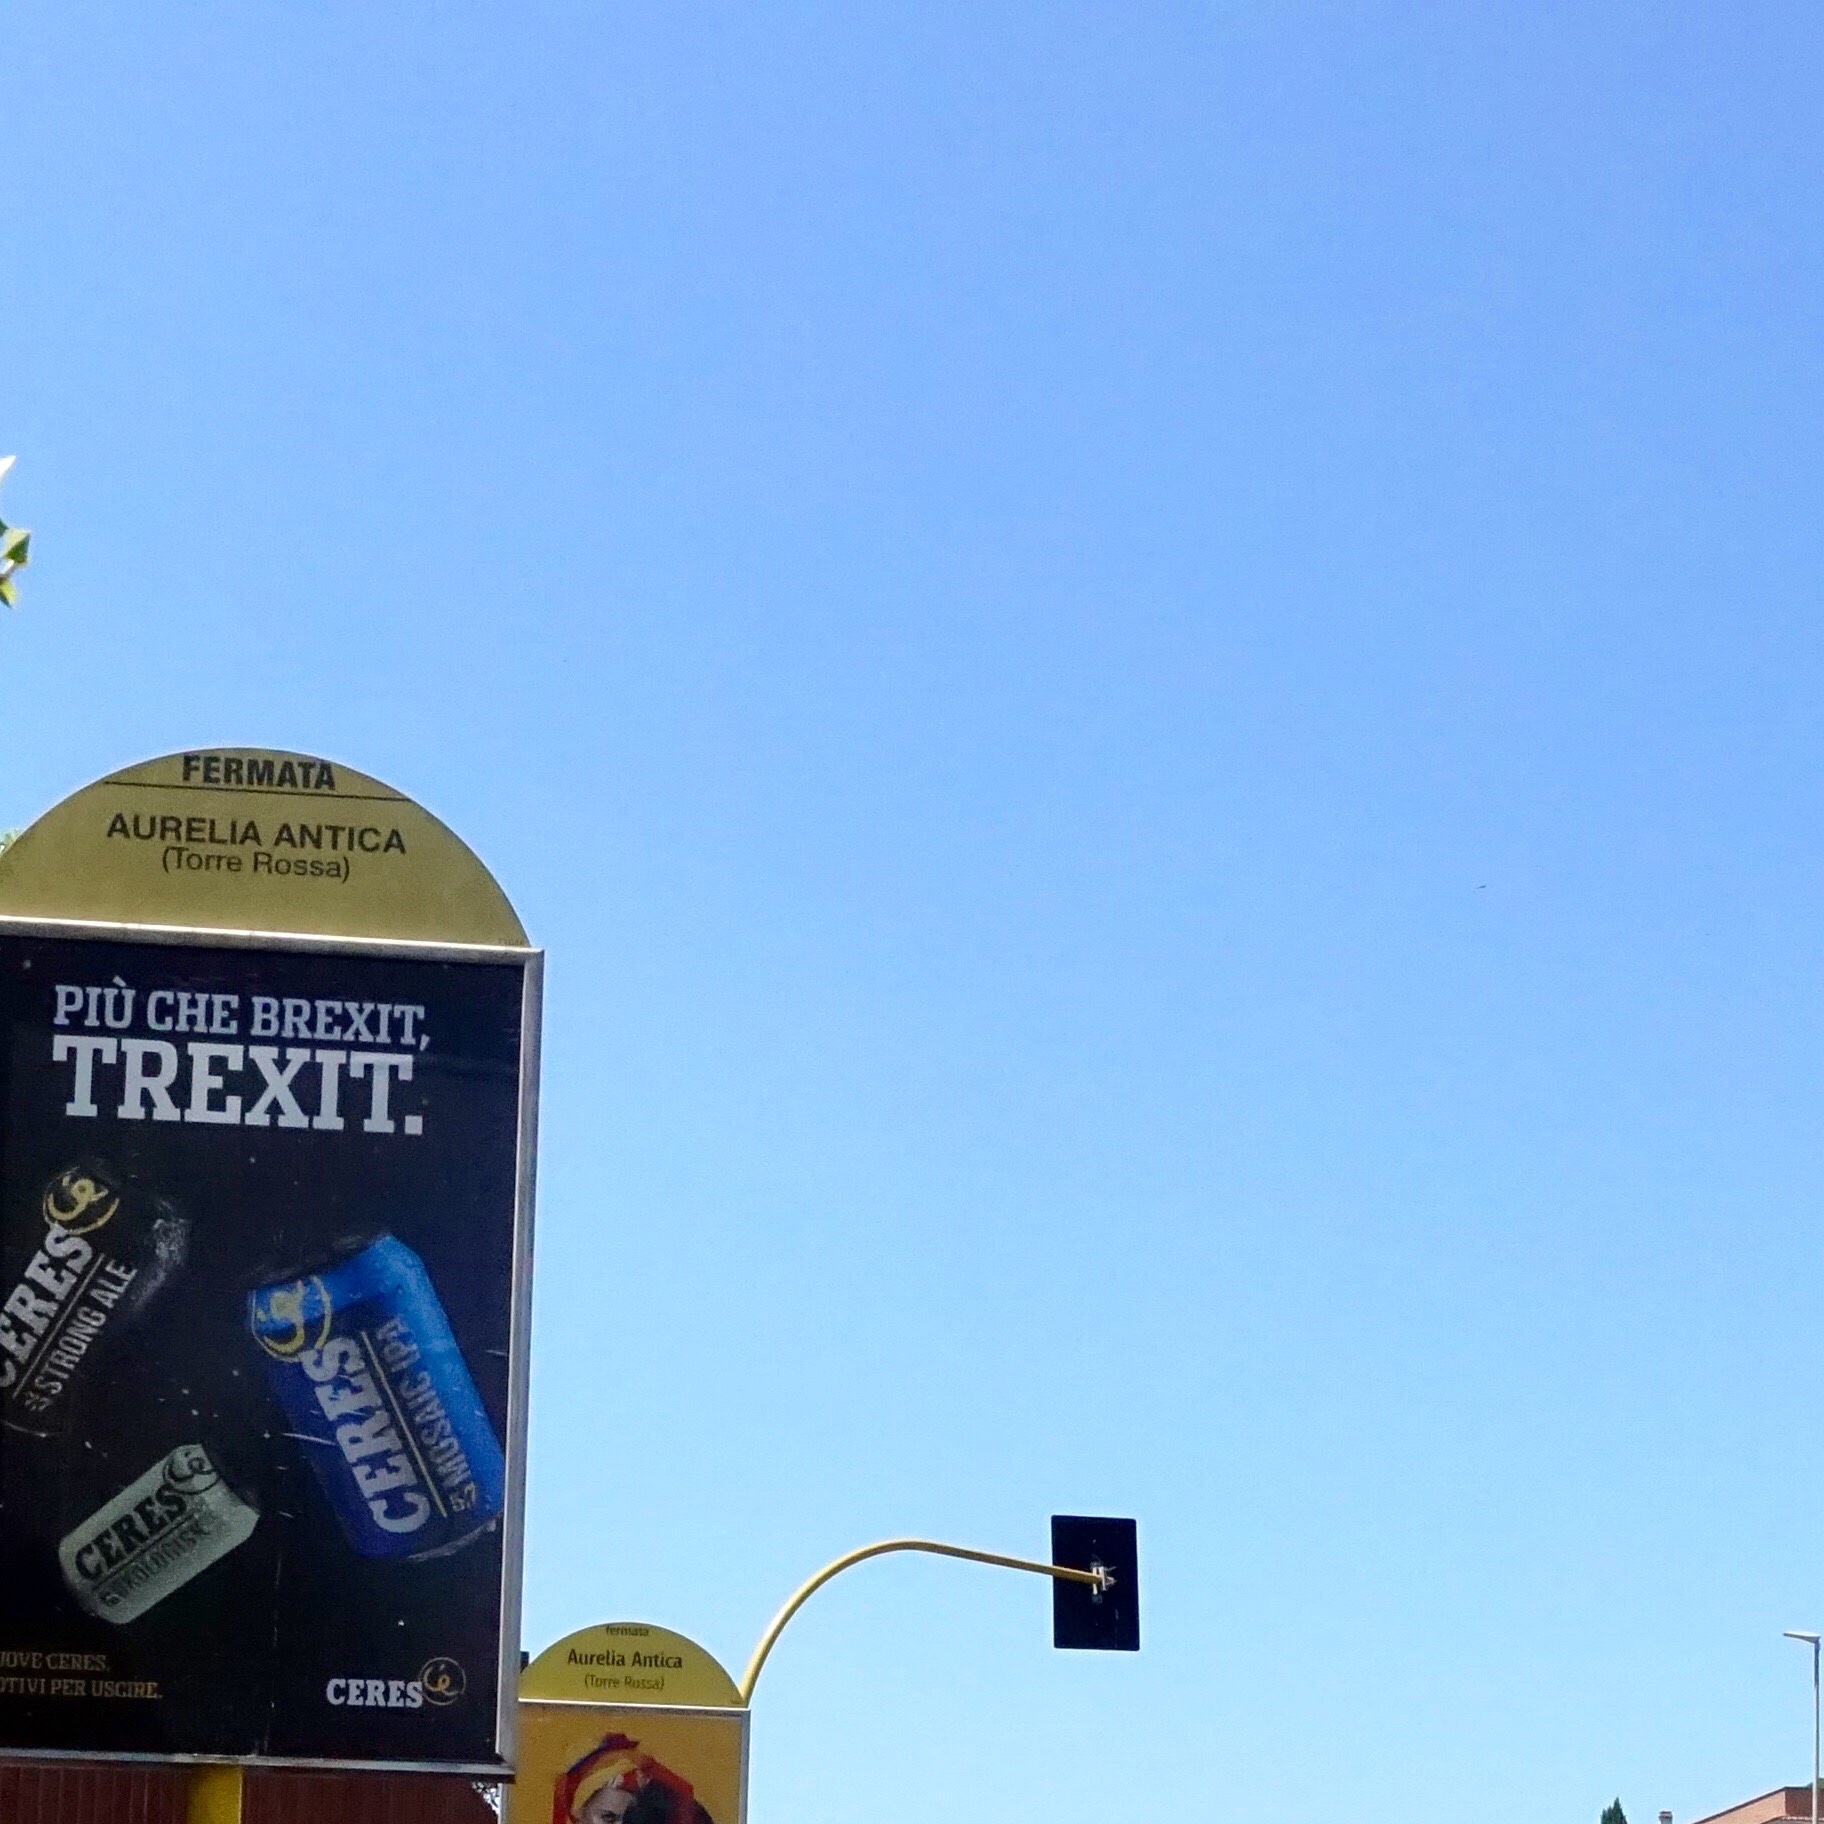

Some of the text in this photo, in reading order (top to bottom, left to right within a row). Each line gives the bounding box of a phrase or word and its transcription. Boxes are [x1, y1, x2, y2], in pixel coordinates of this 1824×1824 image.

[181, 754, 336, 791] FERMATA
[106, 812, 408, 856] AURELIA ANTICA
[162, 846, 350, 884] (Torre Rossa)
[53, 975, 430, 1051] PIÙ CHE BREXIT,
[52, 1034, 424, 1136] TREXIT.
[34, 1305, 108, 1395] STRONG
[89, 1258, 139, 1310] ALE
[377, 1316, 421, 1373] IPA
[299, 1337, 431, 1533] CERES
[398, 1370, 472, 1488] MOSAIC
[75, 1483, 188, 1579] CERES
[567, 1648, 683, 1669] Aurelia Antica
[584, 1673, 665, 1691] (Torre Rossa)
[51, 1679, 86, 1696] PER
[91, 1680, 163, 1699] USCIRE.
[326, 1678, 423, 1708] CERES
